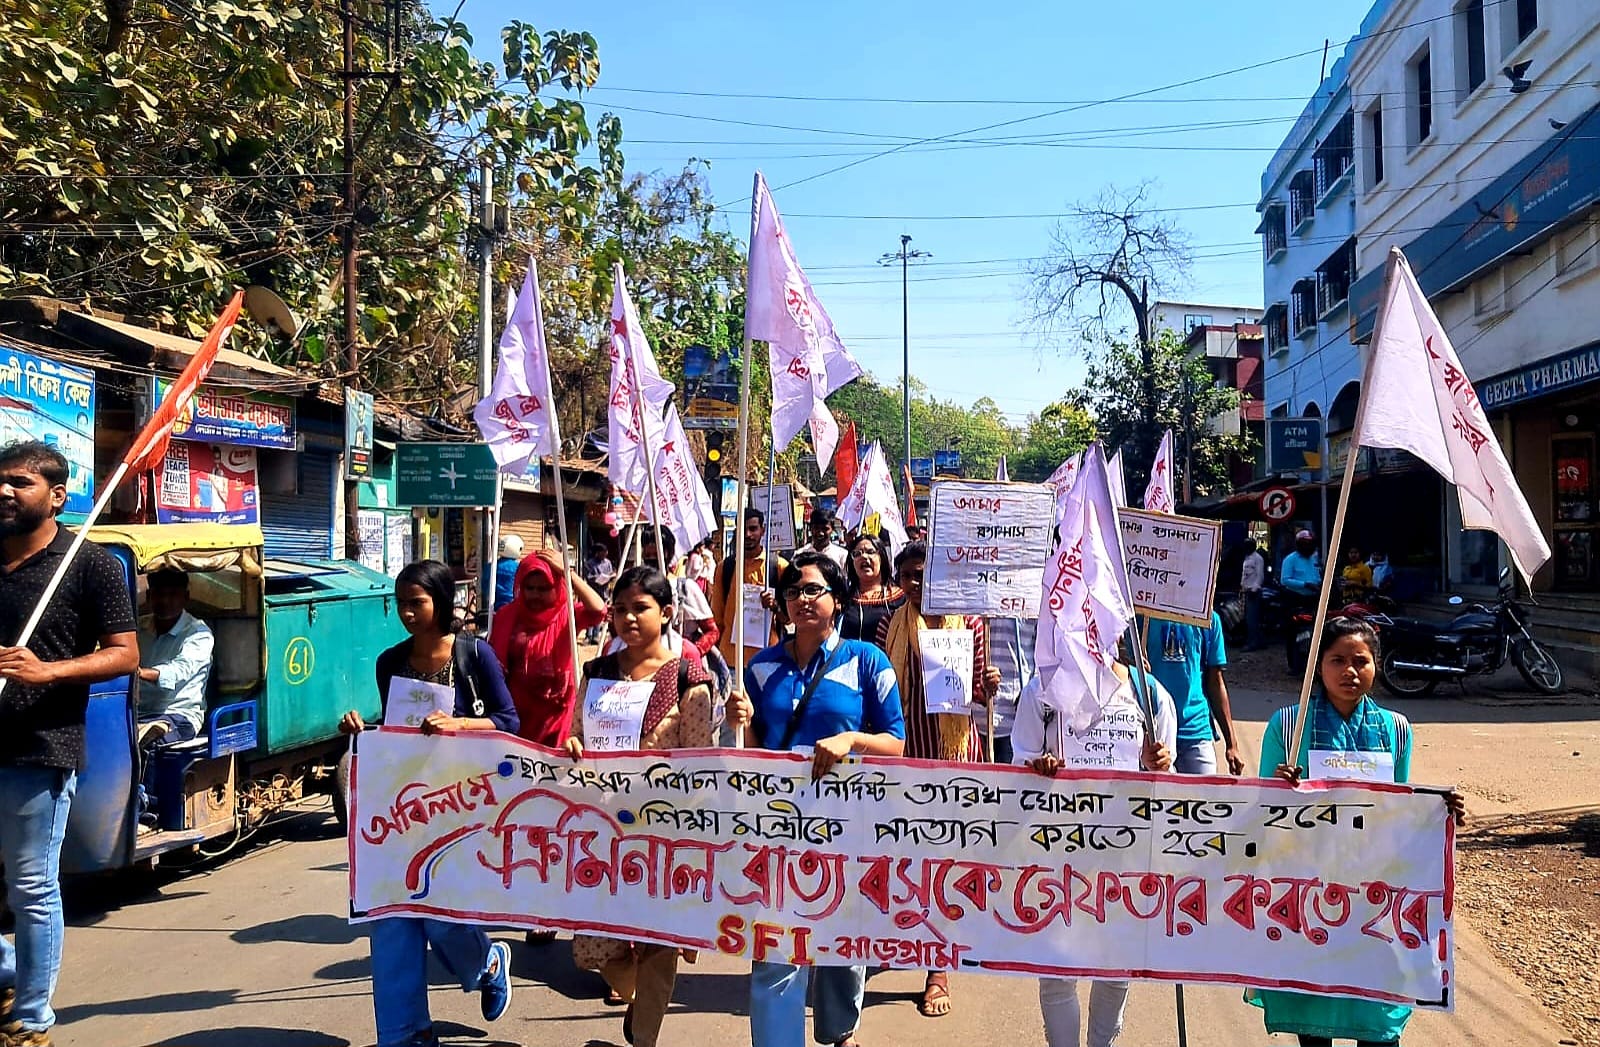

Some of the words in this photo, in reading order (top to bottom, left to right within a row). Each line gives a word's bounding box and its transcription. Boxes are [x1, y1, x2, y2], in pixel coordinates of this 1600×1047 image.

[26, 361, 61, 402] বিক্রয়
[64, 381, 91, 409] কেন্দ্র
[1485, 374, 1527, 404] GEETA
[1531, 350, 1600, 391] PHARMA
[1284, 427, 1308, 436] ATM
[953, 497, 1002, 514] আমার
[946, 546, 999, 563] আমার
[1126, 544, 1171, 561] আমার
[1001, 598, 1026, 611] SFI
[1136, 590, 1157, 604] SFI
[289, 646, 308, 675] 61
[361, 773, 499, 844] অবিলম্বে
[506, 755, 560, 782] ছাত্র
[568, 767, 634, 794] সংসদ
[642, 762, 722, 794] নির্বাচন
[904, 777, 1006, 808] তারিখ
[1128, 797, 1238, 825] করতে
[640, 799, 720, 836] শিক্ষা
[732, 799, 845, 845] মন্ত্রীকে
[875, 819, 1002, 848] পদত্যাগ
[1030, 823, 1140, 853] করতে
[719, 842, 850, 922] ব্রাত্য
[857, 854, 1006, 944] বসুকে
[993, 862, 1208, 937] গ্রেফতার
[1223, 873, 1360, 945] করতে
[716, 914, 813, 967] SFI
